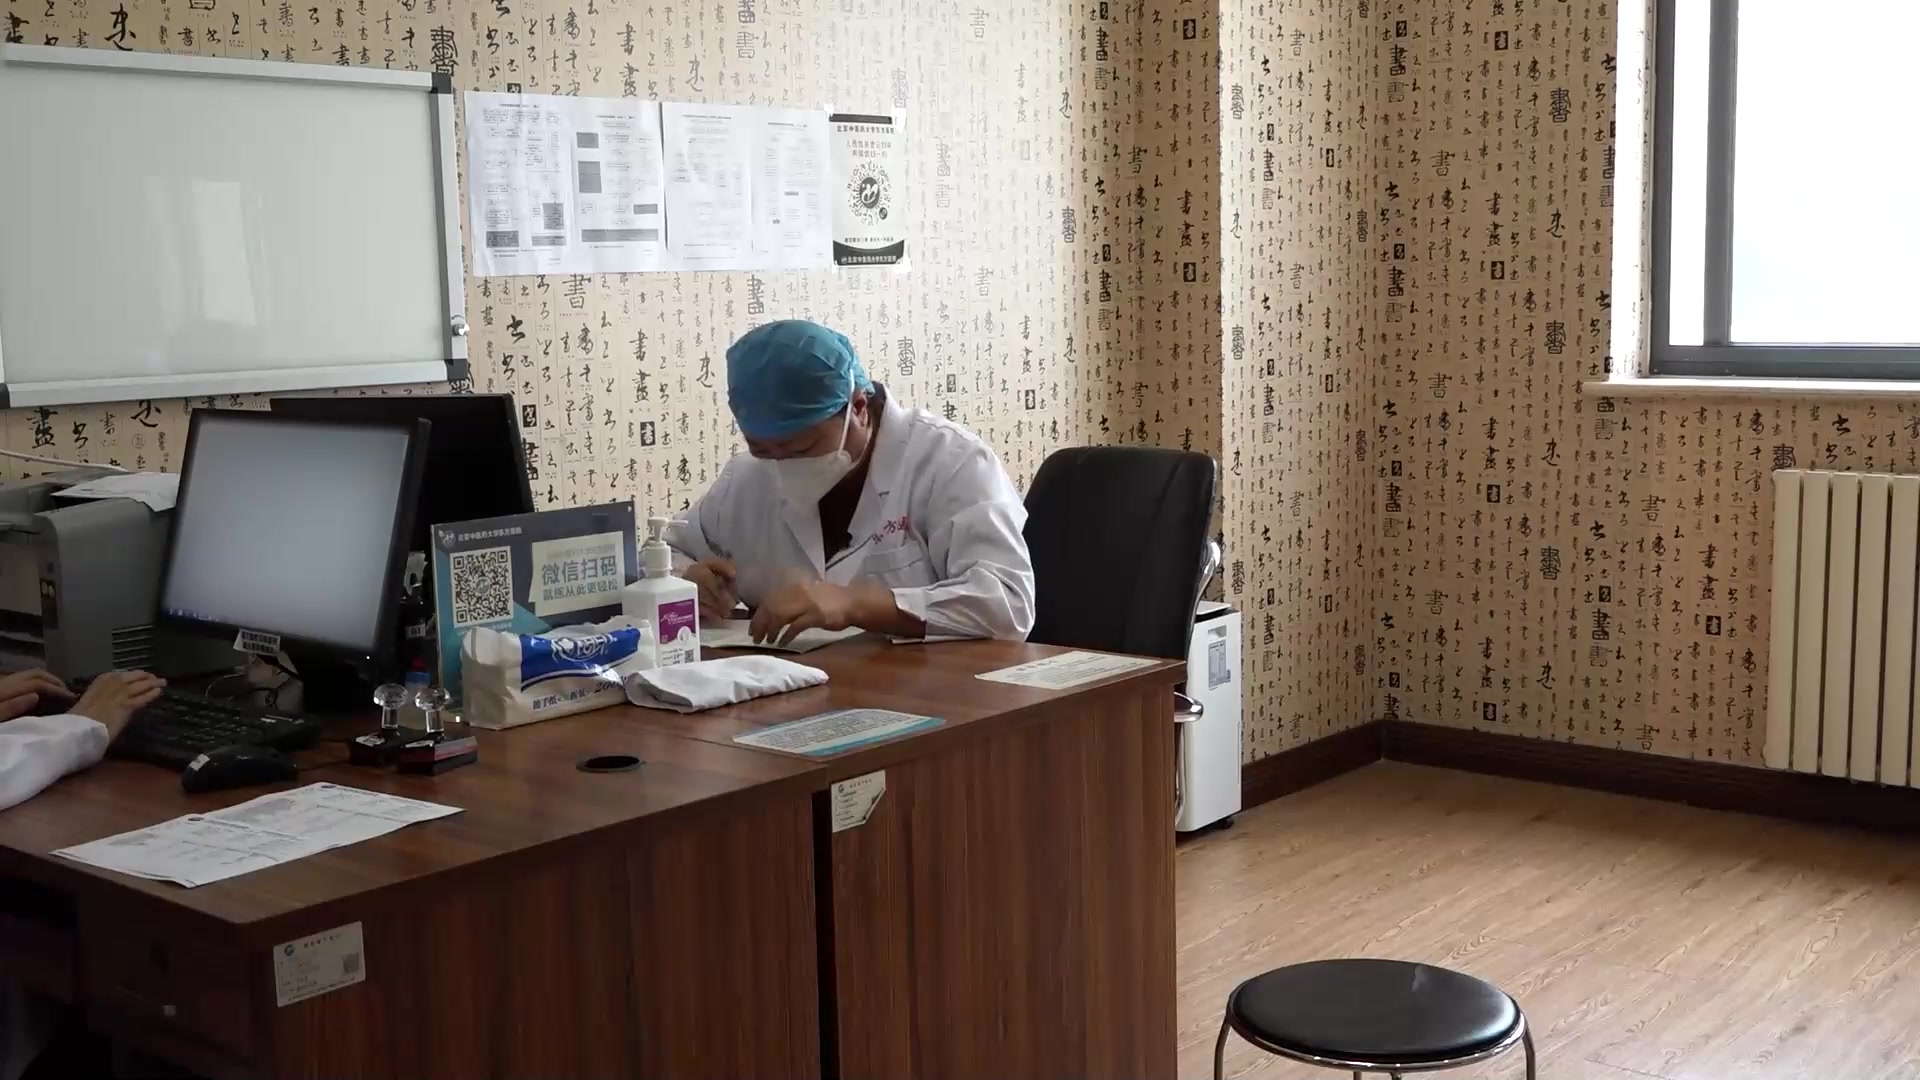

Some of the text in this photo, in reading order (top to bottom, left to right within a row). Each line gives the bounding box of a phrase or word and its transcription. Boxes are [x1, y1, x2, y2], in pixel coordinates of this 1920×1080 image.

[541, 555, 617, 586] 微信扫码
[543, 579, 618, 601] 就医从此更轻松
